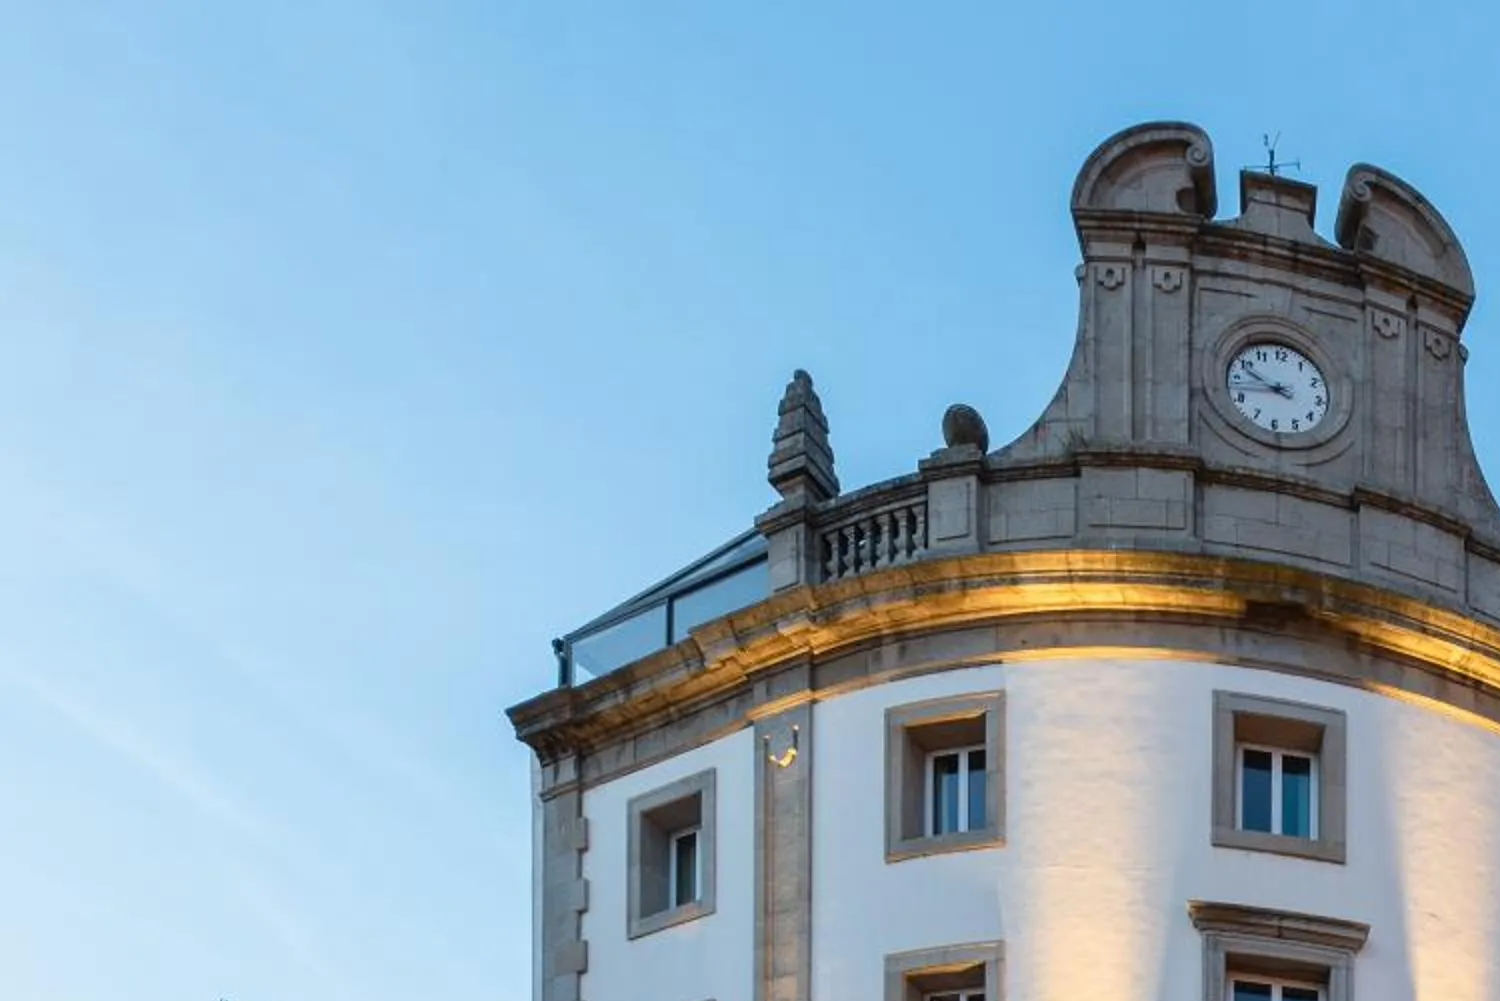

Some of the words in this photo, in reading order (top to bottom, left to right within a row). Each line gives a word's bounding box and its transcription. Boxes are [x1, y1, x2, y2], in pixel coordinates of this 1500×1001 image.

[1256, 351, 1267, 362] 11
[1275, 350, 1288, 362] 12
[1311, 377, 1318, 389] 2
[1238, 393, 1245, 404] 8
[1315, 395, 1323, 406] 3
[1253, 408, 1261, 419] 7
[1306, 411, 1314, 421] 4
[1271, 419, 1279, 430] 6
[1291, 419, 1299, 430] 5
